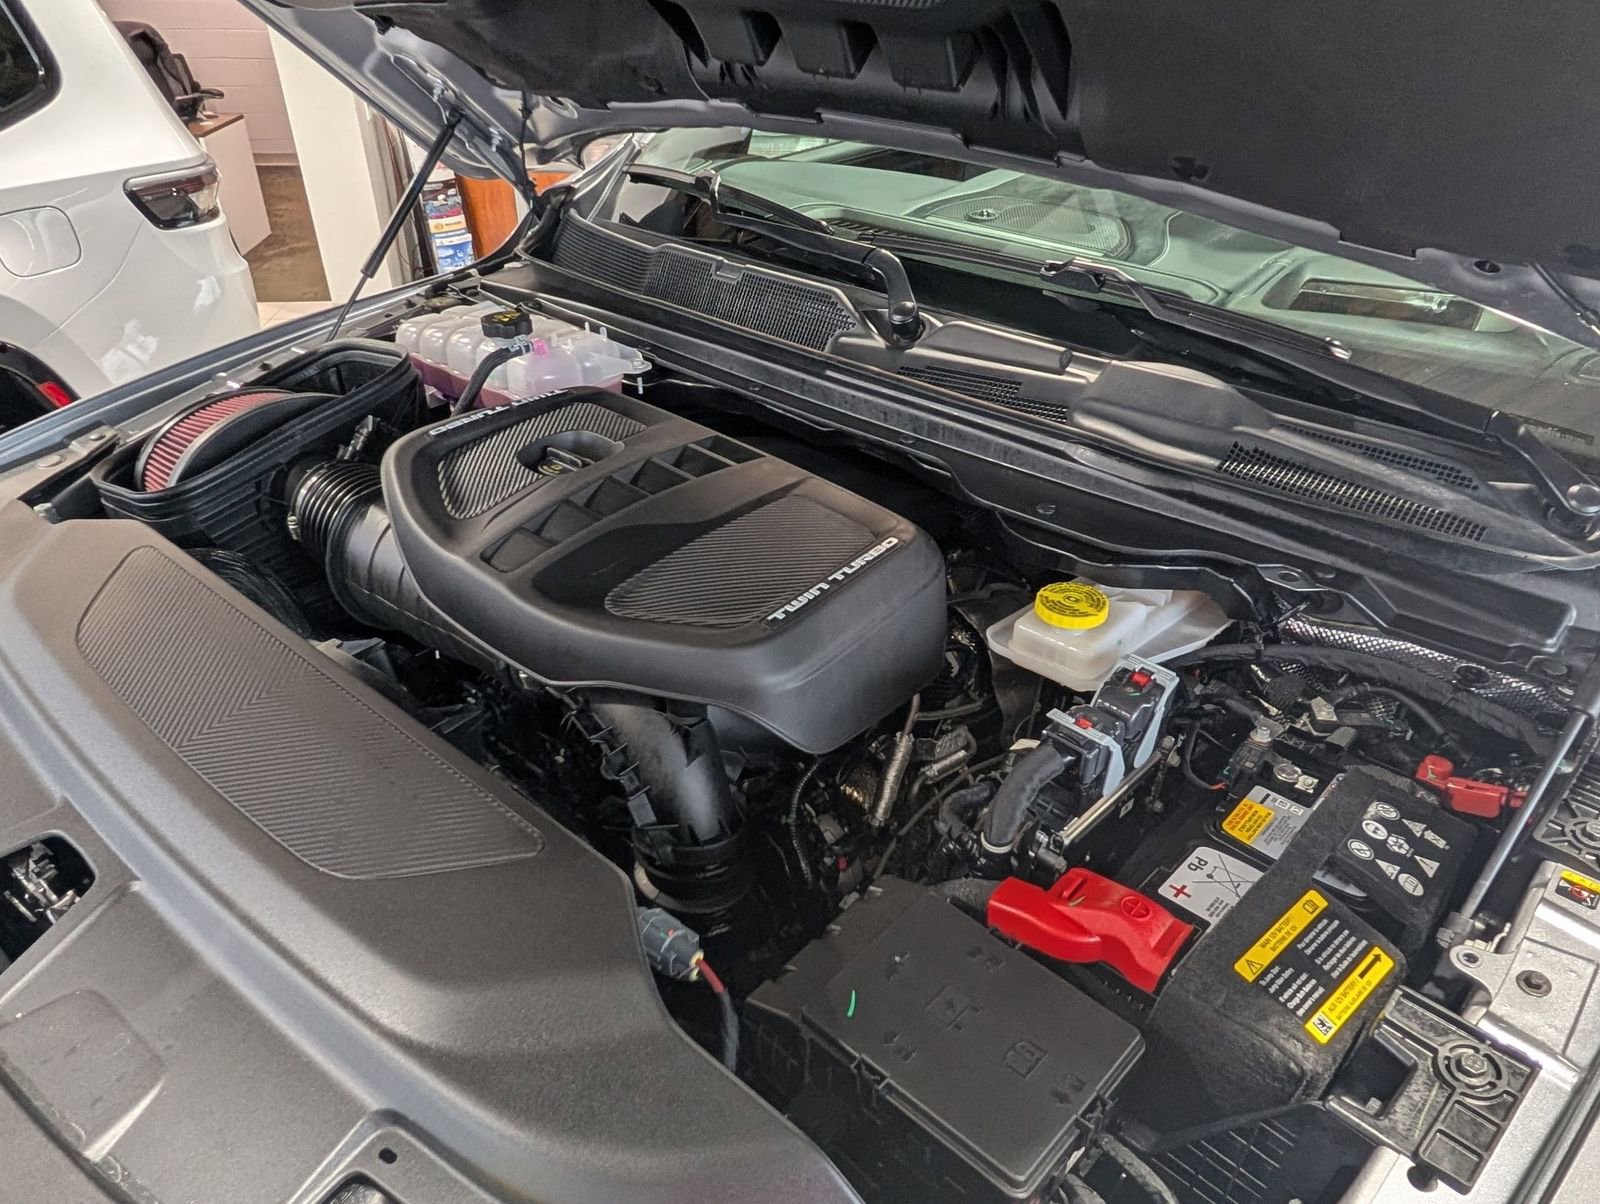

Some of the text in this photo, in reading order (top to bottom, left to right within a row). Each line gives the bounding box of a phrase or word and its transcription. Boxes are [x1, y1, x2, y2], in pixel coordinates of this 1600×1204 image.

[767, 536, 900, 622] TWIN TURBO
[1187, 856, 1209, 872] Pb
